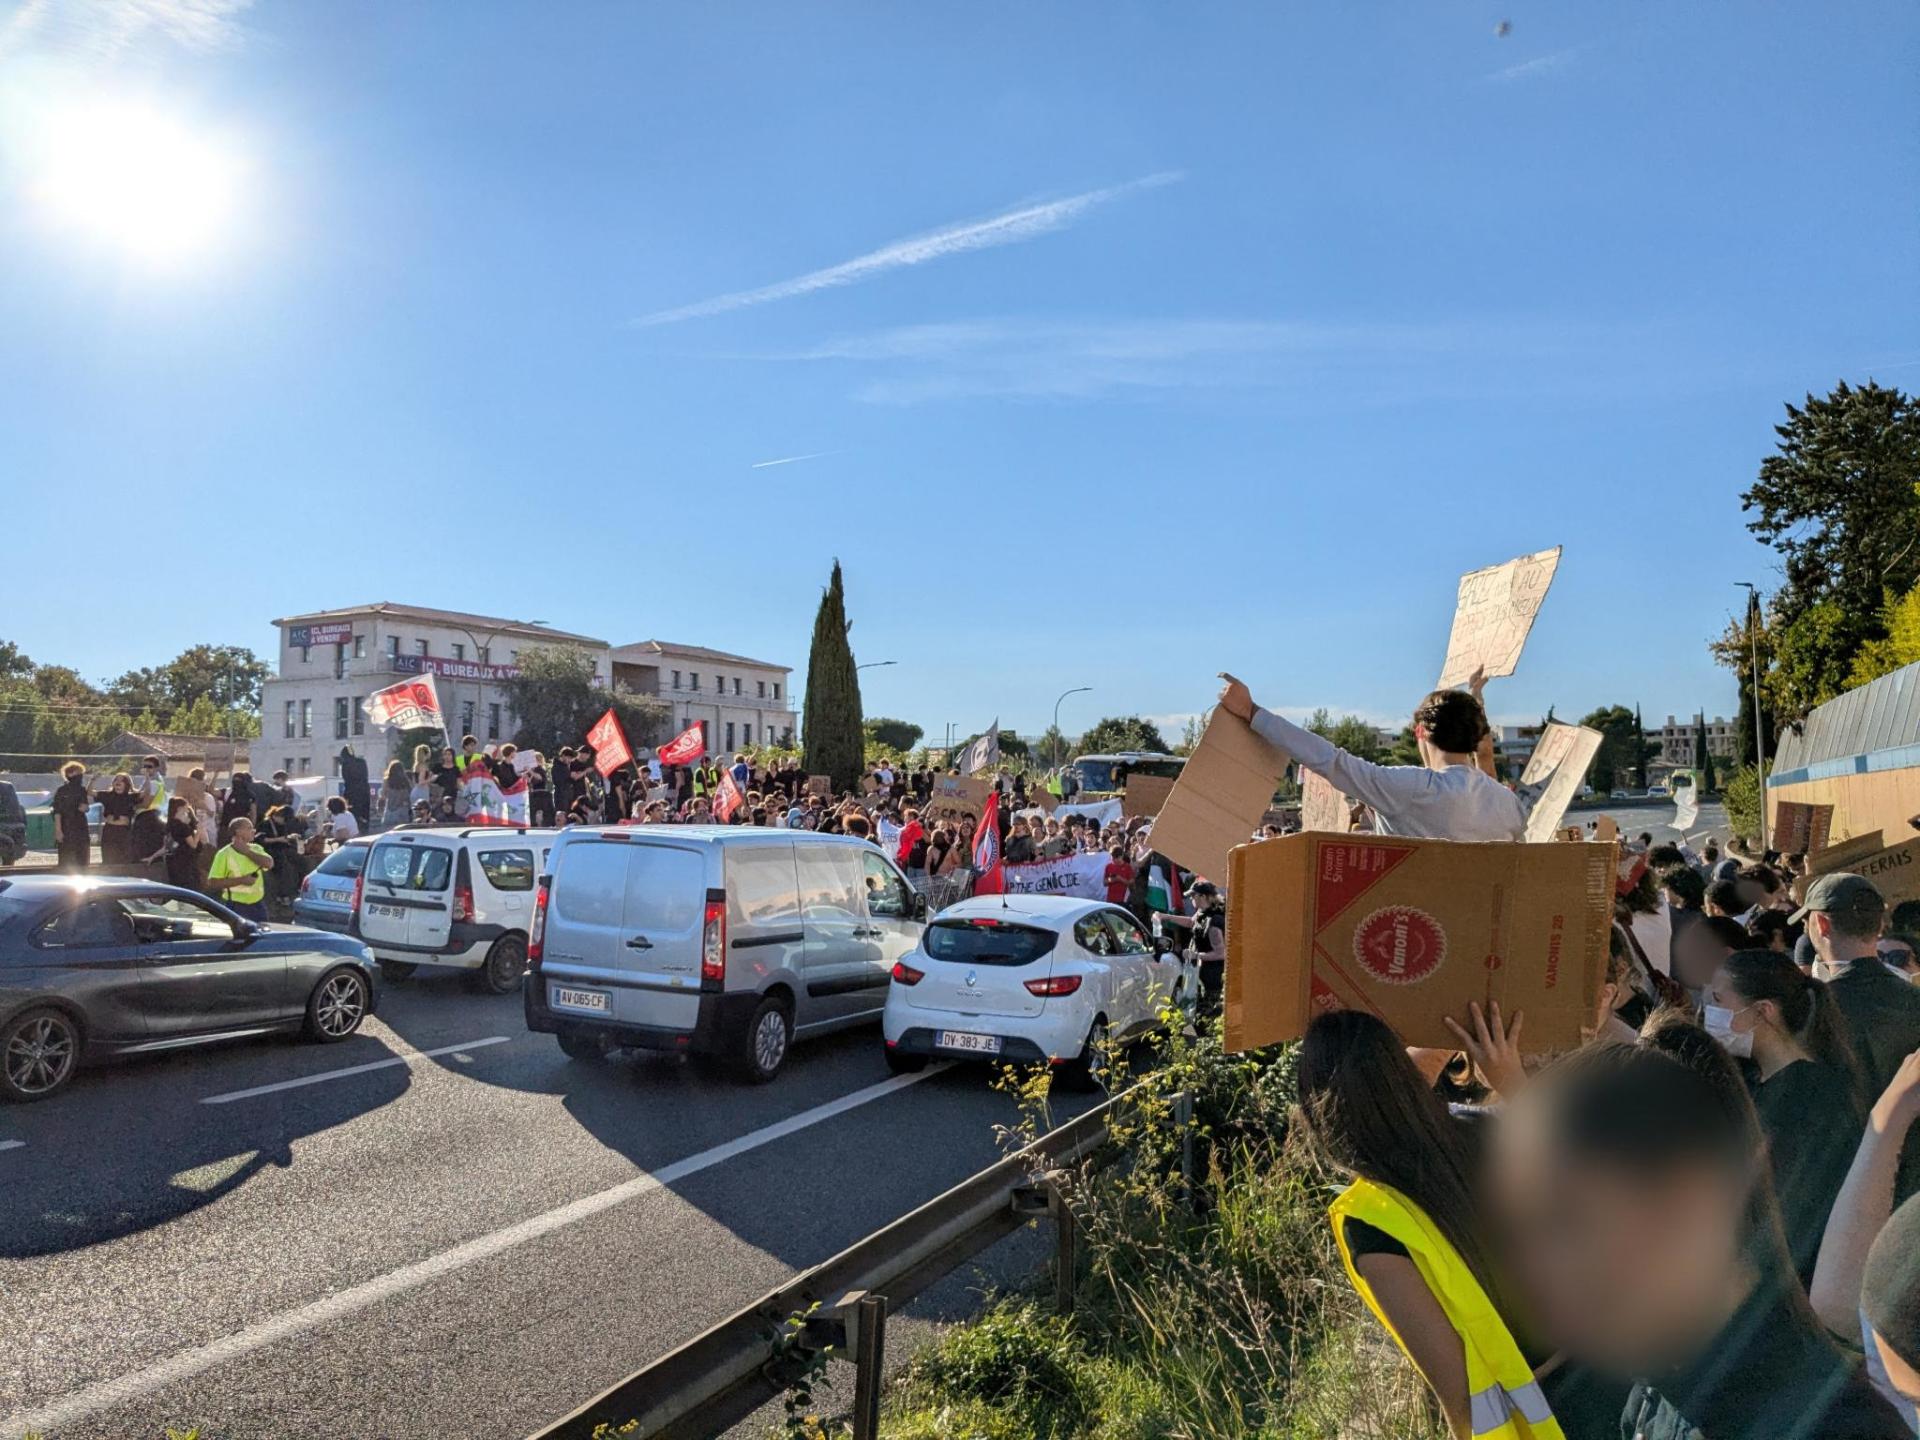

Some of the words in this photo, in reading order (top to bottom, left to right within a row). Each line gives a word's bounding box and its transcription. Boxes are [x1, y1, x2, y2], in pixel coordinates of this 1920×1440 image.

[443, 663, 494, 679] BUREAUX
[1323, 847, 1334, 881] Frozen
[1333, 847, 1346, 882] Shrimp
[1016, 881, 1034, 893] THE
[1388, 914, 1409, 975] Vanoni's
